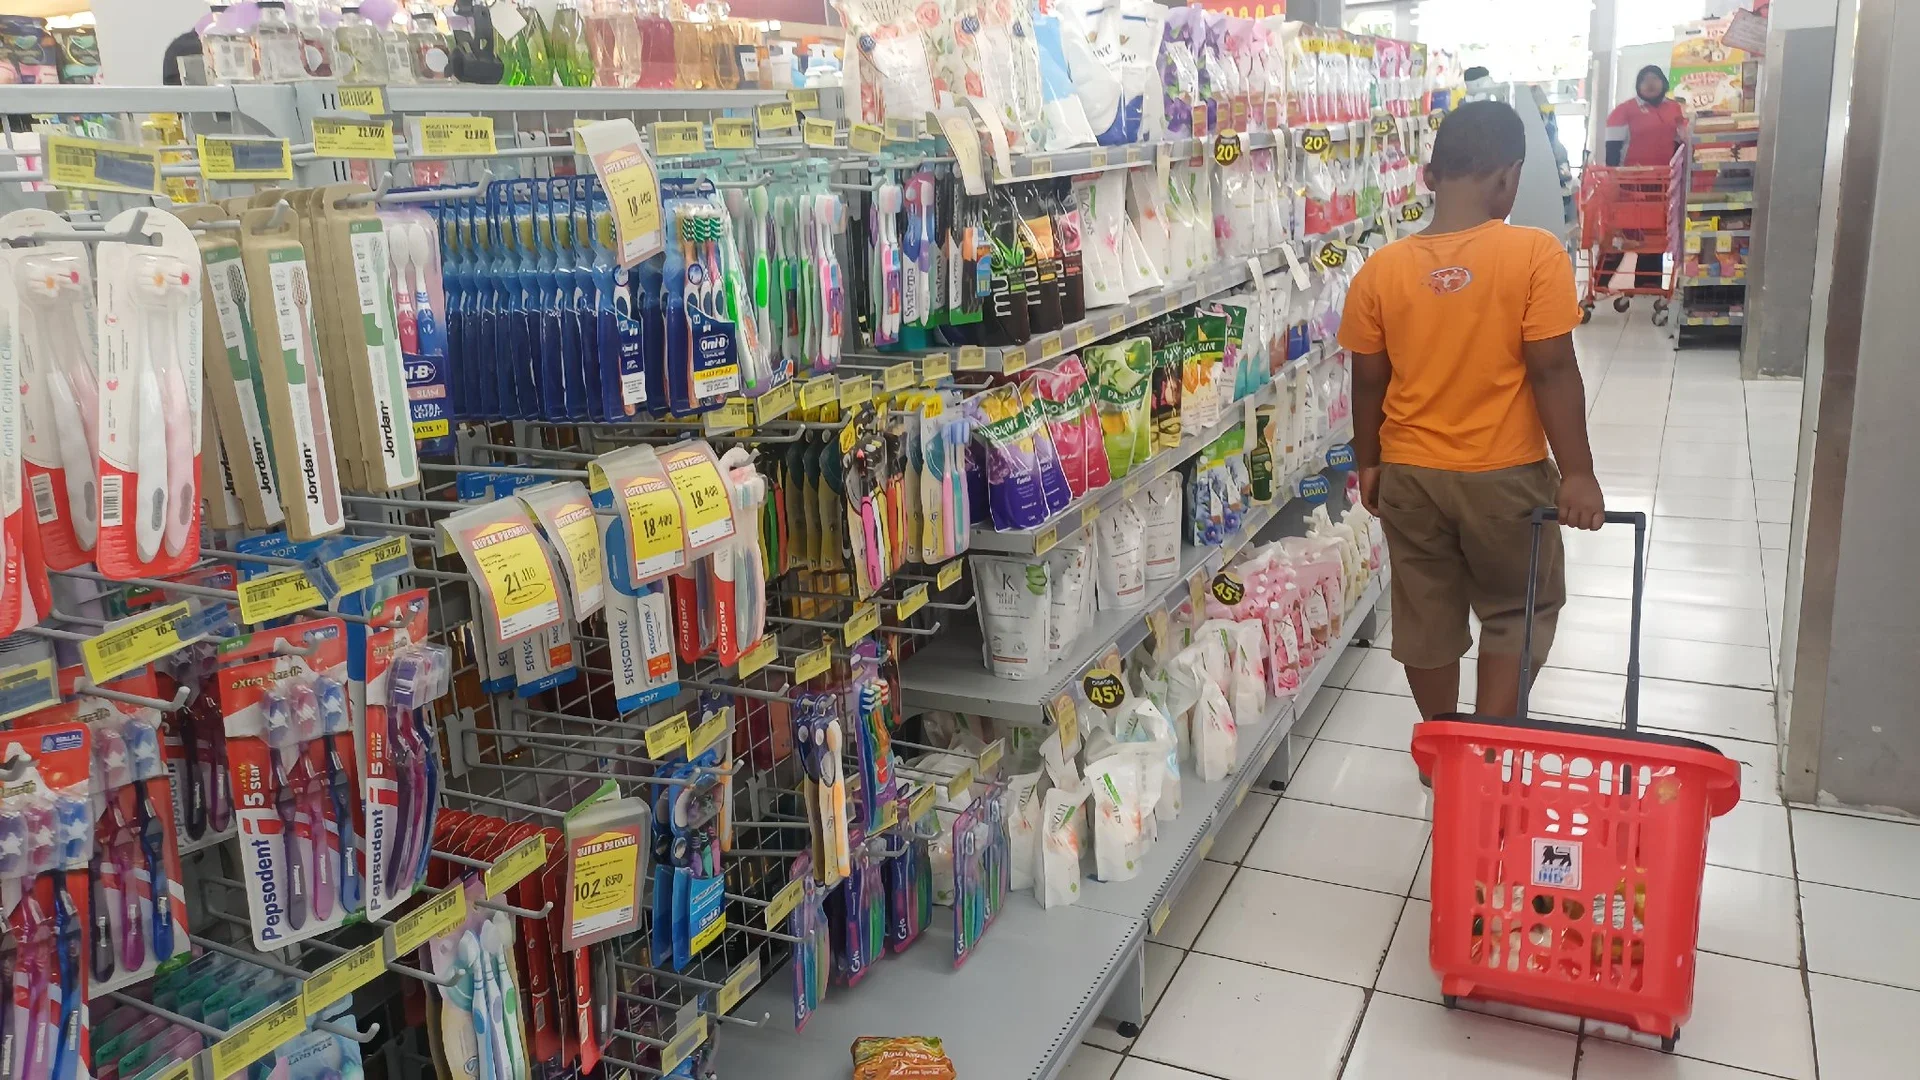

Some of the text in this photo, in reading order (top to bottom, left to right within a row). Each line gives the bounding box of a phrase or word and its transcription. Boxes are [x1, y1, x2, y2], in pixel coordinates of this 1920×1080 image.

[904, 268, 916, 317] Systema
[380, 401, 396, 459] Jordan
[252, 436, 272, 495] Jordan
[302, 443, 319, 505] Jordan
[271, 545, 297, 557] SOFT
[503, 566, 537, 596] 21.110
[617, 618, 635, 687] SENSODYNE
[719, 601, 729, 655] Colgate
[1091, 684, 1125, 704] 45%
[371, 763, 384, 776] 5
[244, 792, 265, 807] 5
[370, 808, 384, 911] Pepsodent
[251, 838, 283, 942] Pepsodent
